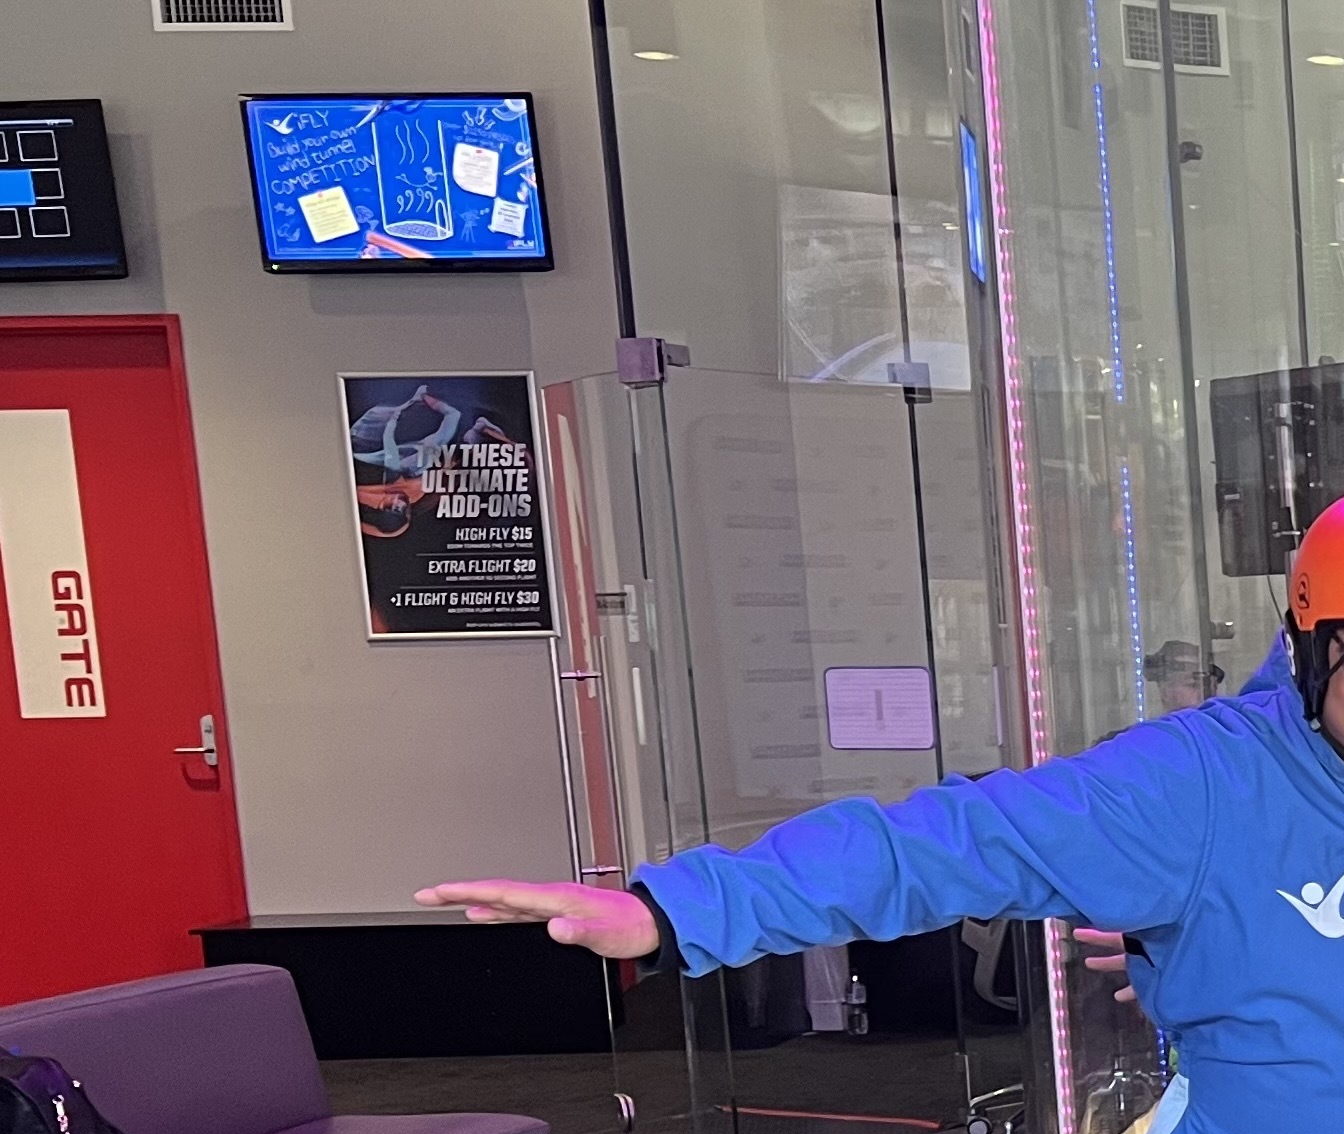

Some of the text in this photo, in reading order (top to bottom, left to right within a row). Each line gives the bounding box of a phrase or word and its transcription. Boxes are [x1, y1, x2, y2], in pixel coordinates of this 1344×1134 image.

[267, 126, 356, 158] Build your own
[278, 139, 356, 172] wind tunnel
[271, 154, 376, 194] COMPETITION
[416, 443, 527, 468] TRY THESE
[422, 468, 529, 493] ULTIMATE
[436, 494, 532, 518] ADD-ONS
[455, 526, 533, 541] HIGH FLY $15
[428, 558, 536, 574] EXTRA FLIGHT $20
[404, 592, 448, 606] FLIGHT
[450, 593, 459, 605] &
[461, 592, 492, 605] HIGH
[494, 592, 515, 605] FLY
[516, 590, 540, 605] $30
[51, 570, 97, 707] GATE
